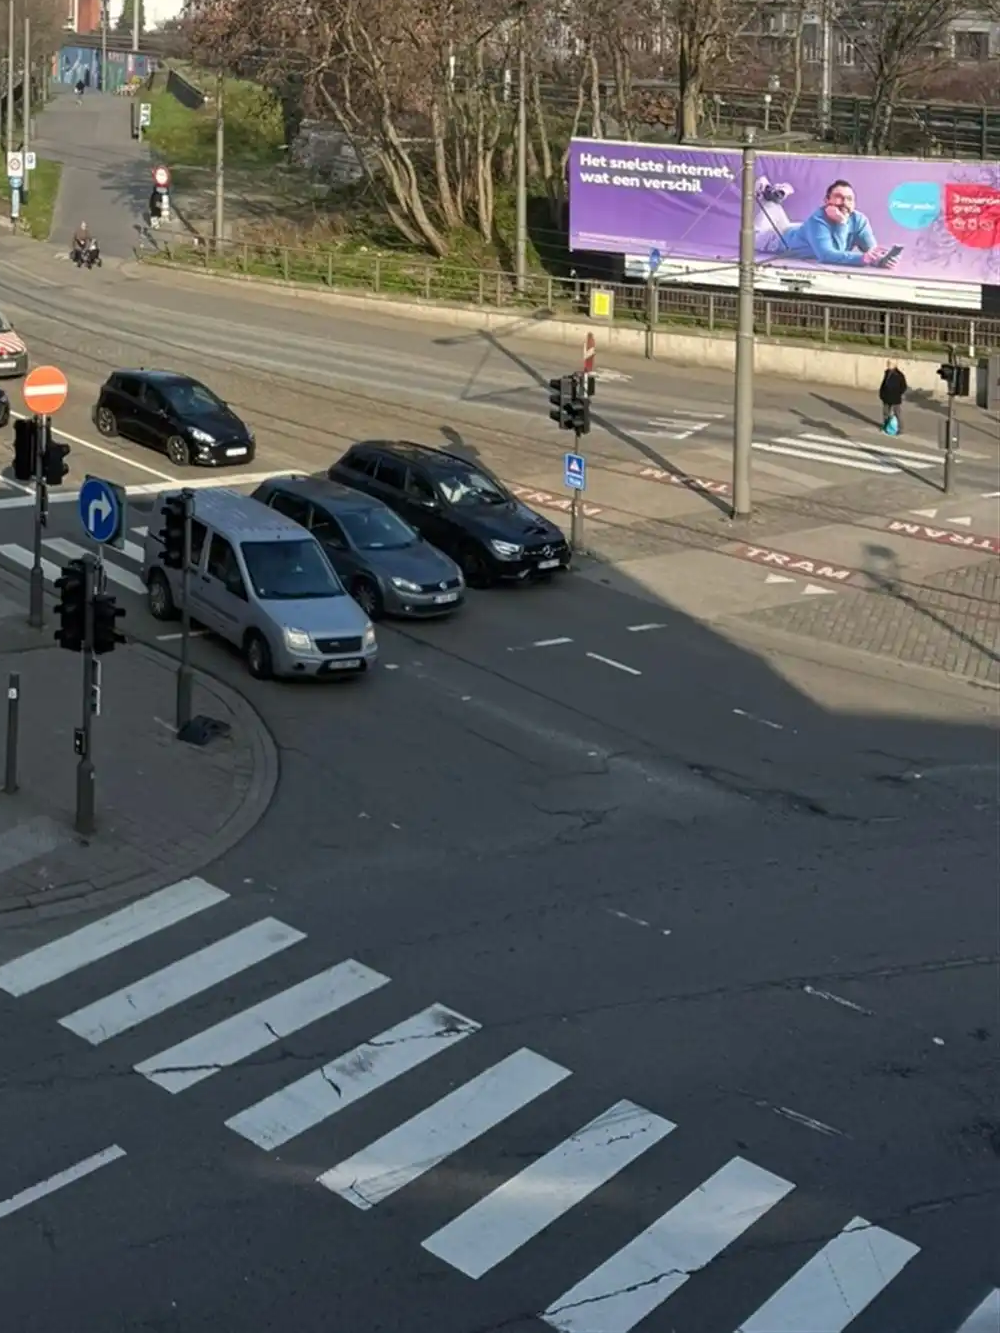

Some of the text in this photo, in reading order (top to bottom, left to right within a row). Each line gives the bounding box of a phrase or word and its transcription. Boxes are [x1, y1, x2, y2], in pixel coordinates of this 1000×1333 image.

[580, 153, 735, 180] Het snelste internet,
[580, 171, 703, 193] wat een verschil
[888, 521, 994, 550] TRAM
[746, 546, 851, 580] TRAM
